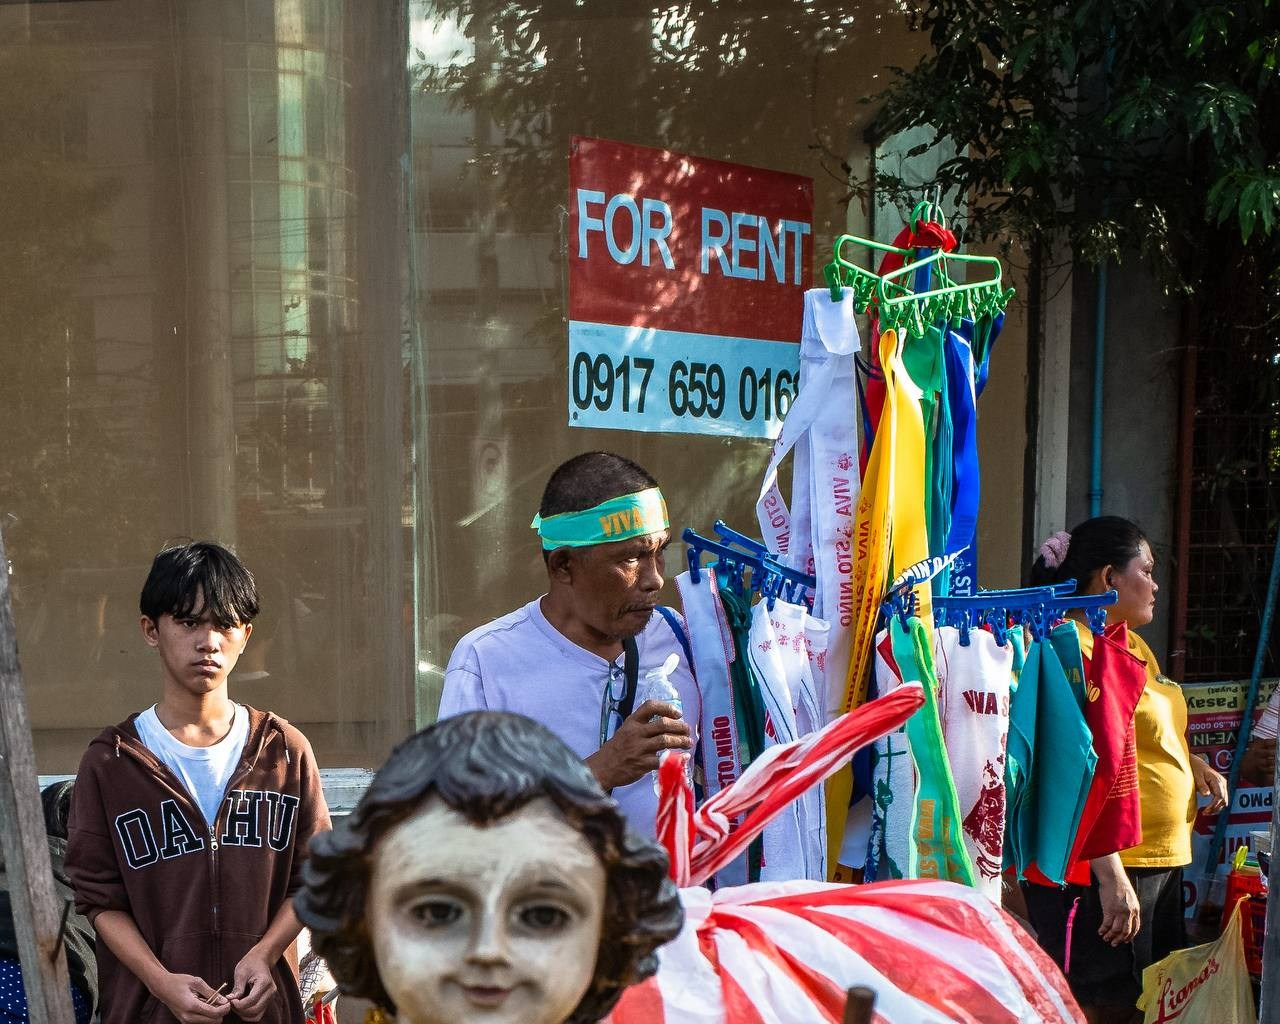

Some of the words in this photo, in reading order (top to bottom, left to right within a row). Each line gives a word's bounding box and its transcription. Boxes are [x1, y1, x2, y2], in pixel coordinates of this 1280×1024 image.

[577, 188, 675, 270] FOR
[701, 207, 811, 286] RENT
[572, 351, 655, 414] 0917
[669, 360, 726, 418] 659
[599, 507, 643, 538] VIVA
[857, 520, 871, 561] VIVA
[955, 576, 971, 597] ST
[1188, 696, 1238, 709] Pasay
[1193, 730, 1237, 747] VE-IN
